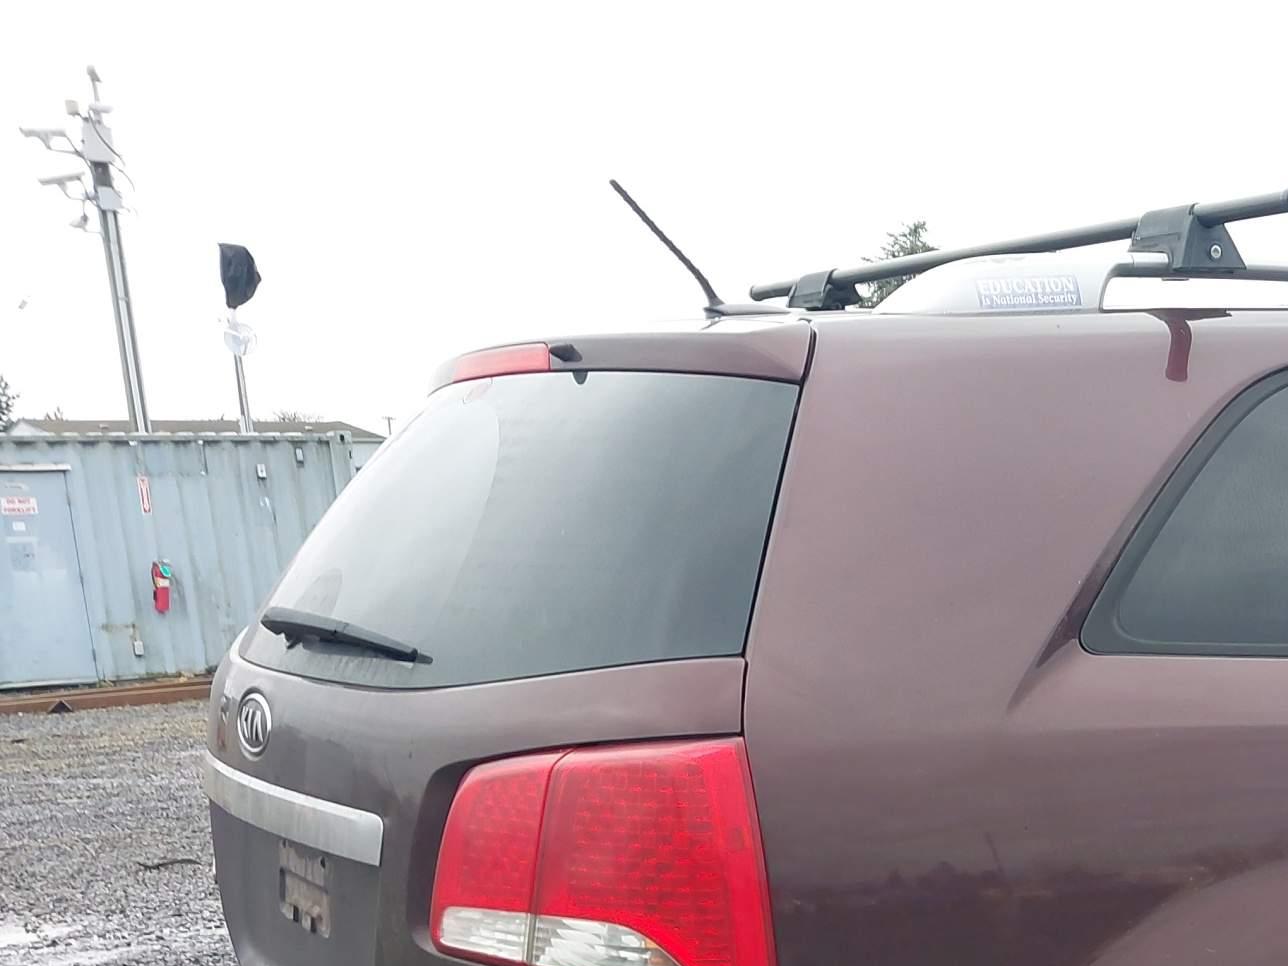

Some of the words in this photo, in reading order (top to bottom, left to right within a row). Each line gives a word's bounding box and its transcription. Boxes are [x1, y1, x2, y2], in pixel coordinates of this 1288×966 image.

[976, 277, 1075, 295] EDUCATION
[993, 294, 1036, 305] National
[1038, 293, 1078, 305] Security
